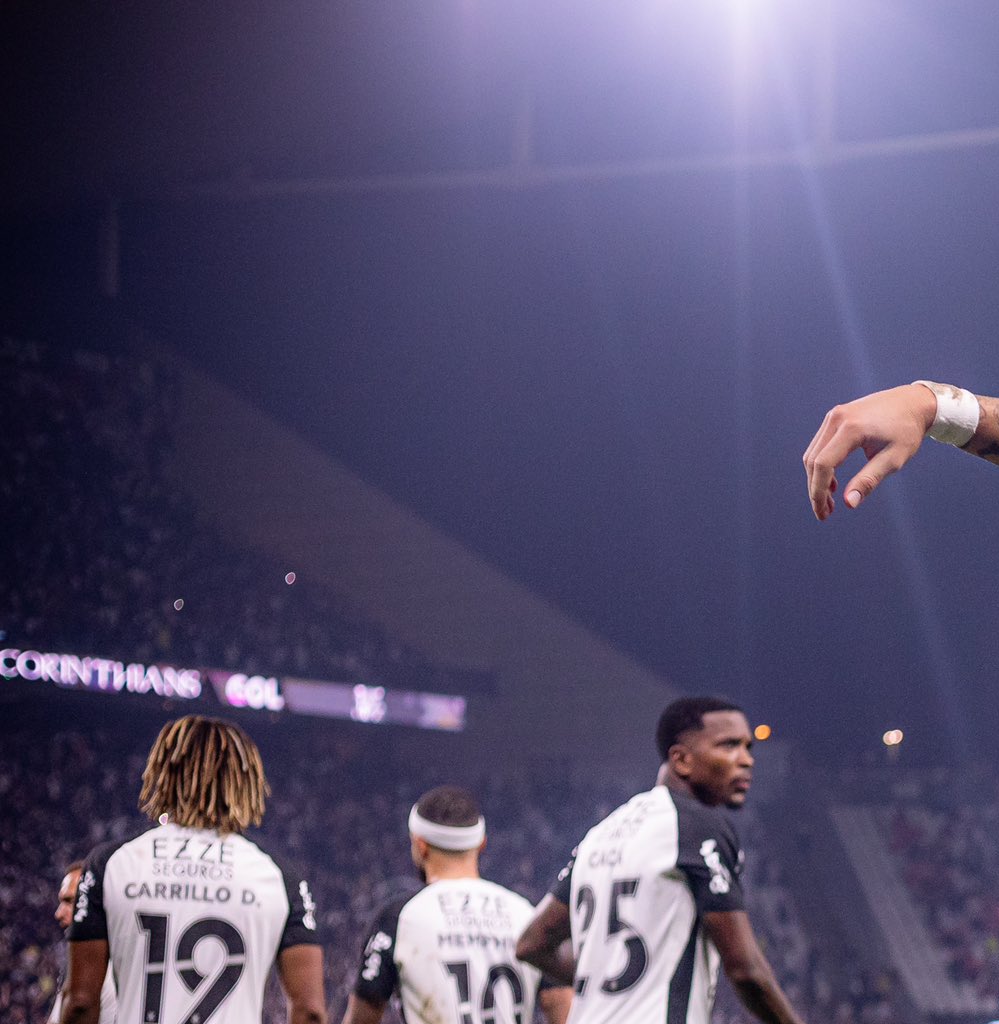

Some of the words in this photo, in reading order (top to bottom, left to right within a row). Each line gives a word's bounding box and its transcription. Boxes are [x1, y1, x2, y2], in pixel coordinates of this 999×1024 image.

[0, 647, 202, 699] CORINTHIANS
[151, 837, 235, 866] EZZE
[151, 861, 234, 881] SEGUROS
[124, 882, 231, 905] CARRILLO
[241, 888, 262, 910] D.
